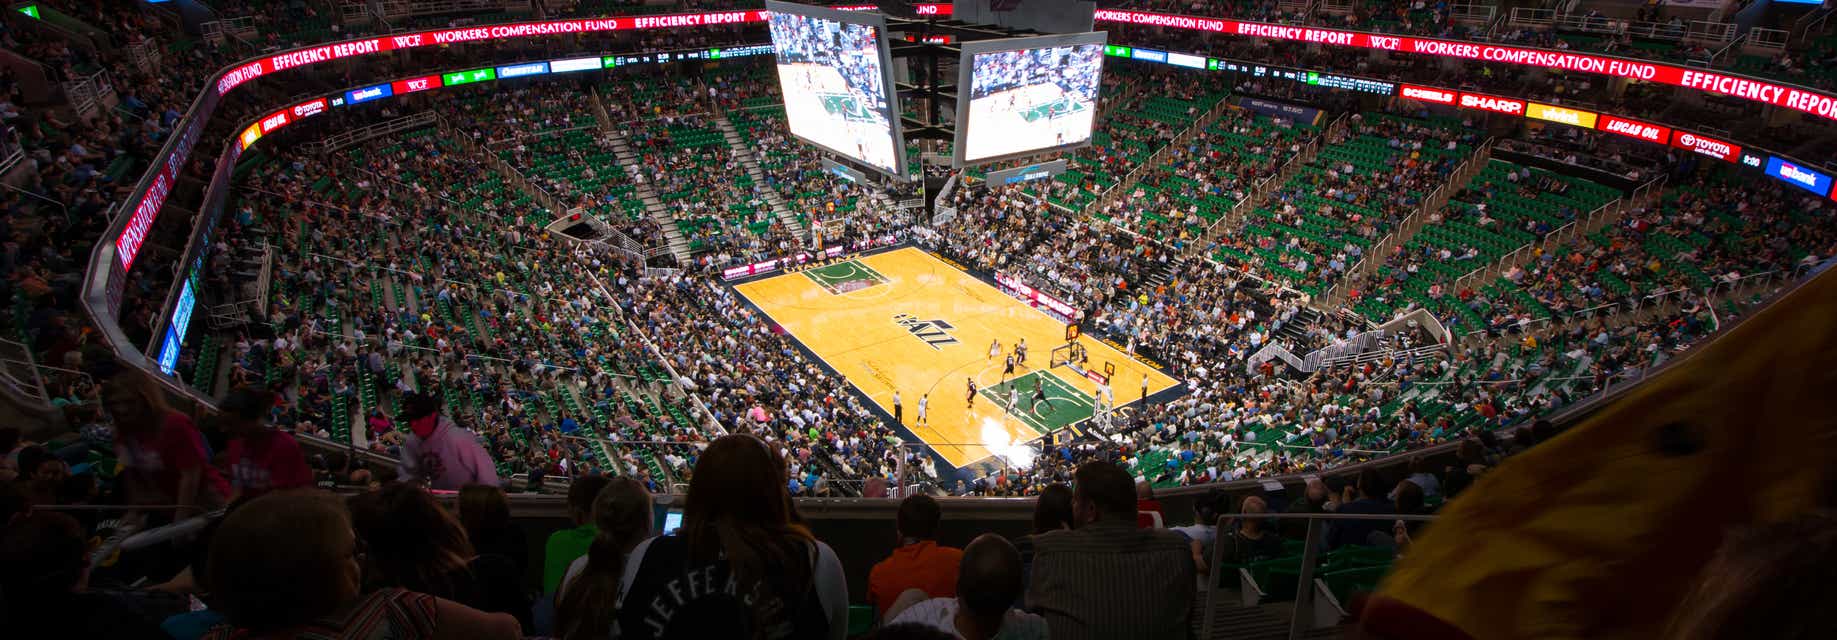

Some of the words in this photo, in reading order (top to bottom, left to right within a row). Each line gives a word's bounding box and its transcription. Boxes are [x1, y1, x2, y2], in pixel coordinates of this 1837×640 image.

[634, 14, 700, 29] EFFICIENCY
[703, 12, 746, 25] REPORT
[1094, 10, 1131, 23] WORKERS
[1132, 13, 1196, 29] COMPENSATION
[1198, 19, 1224, 32] FUND
[433, 28, 489, 43] WORKERS
[491, 21, 582, 38] COMPENSATION
[584, 19, 617, 31] FUND
[1237, 22, 1302, 40] EFFICIENCY
[1304, 29, 1355, 46] REPORT
[394, 34, 421, 48] WCF
[1370, 35, 1400, 50] WCF
[272, 46, 331, 72] EFFICIENCY
[333, 39, 379, 59] REPORT
[1413, 40, 1480, 59] WORKERS
[1483, 47, 1605, 73] COMPENSATION
[1608, 60, 1656, 80] FUND
[407, 79, 427, 91] WCF
[1680, 70, 1785, 104] EFFICIENCY
[1403, 87, 1453, 103] SCHEELS
[302, 101, 324, 113] TOYOTA
[1461, 95, 1522, 114] SHARP
[1606, 119, 1642, 136] LUCAS
[1641, 126, 1660, 140] OIL
[1695, 138, 1731, 156] TOYOTA
[1743, 154, 1761, 168] 9:00
